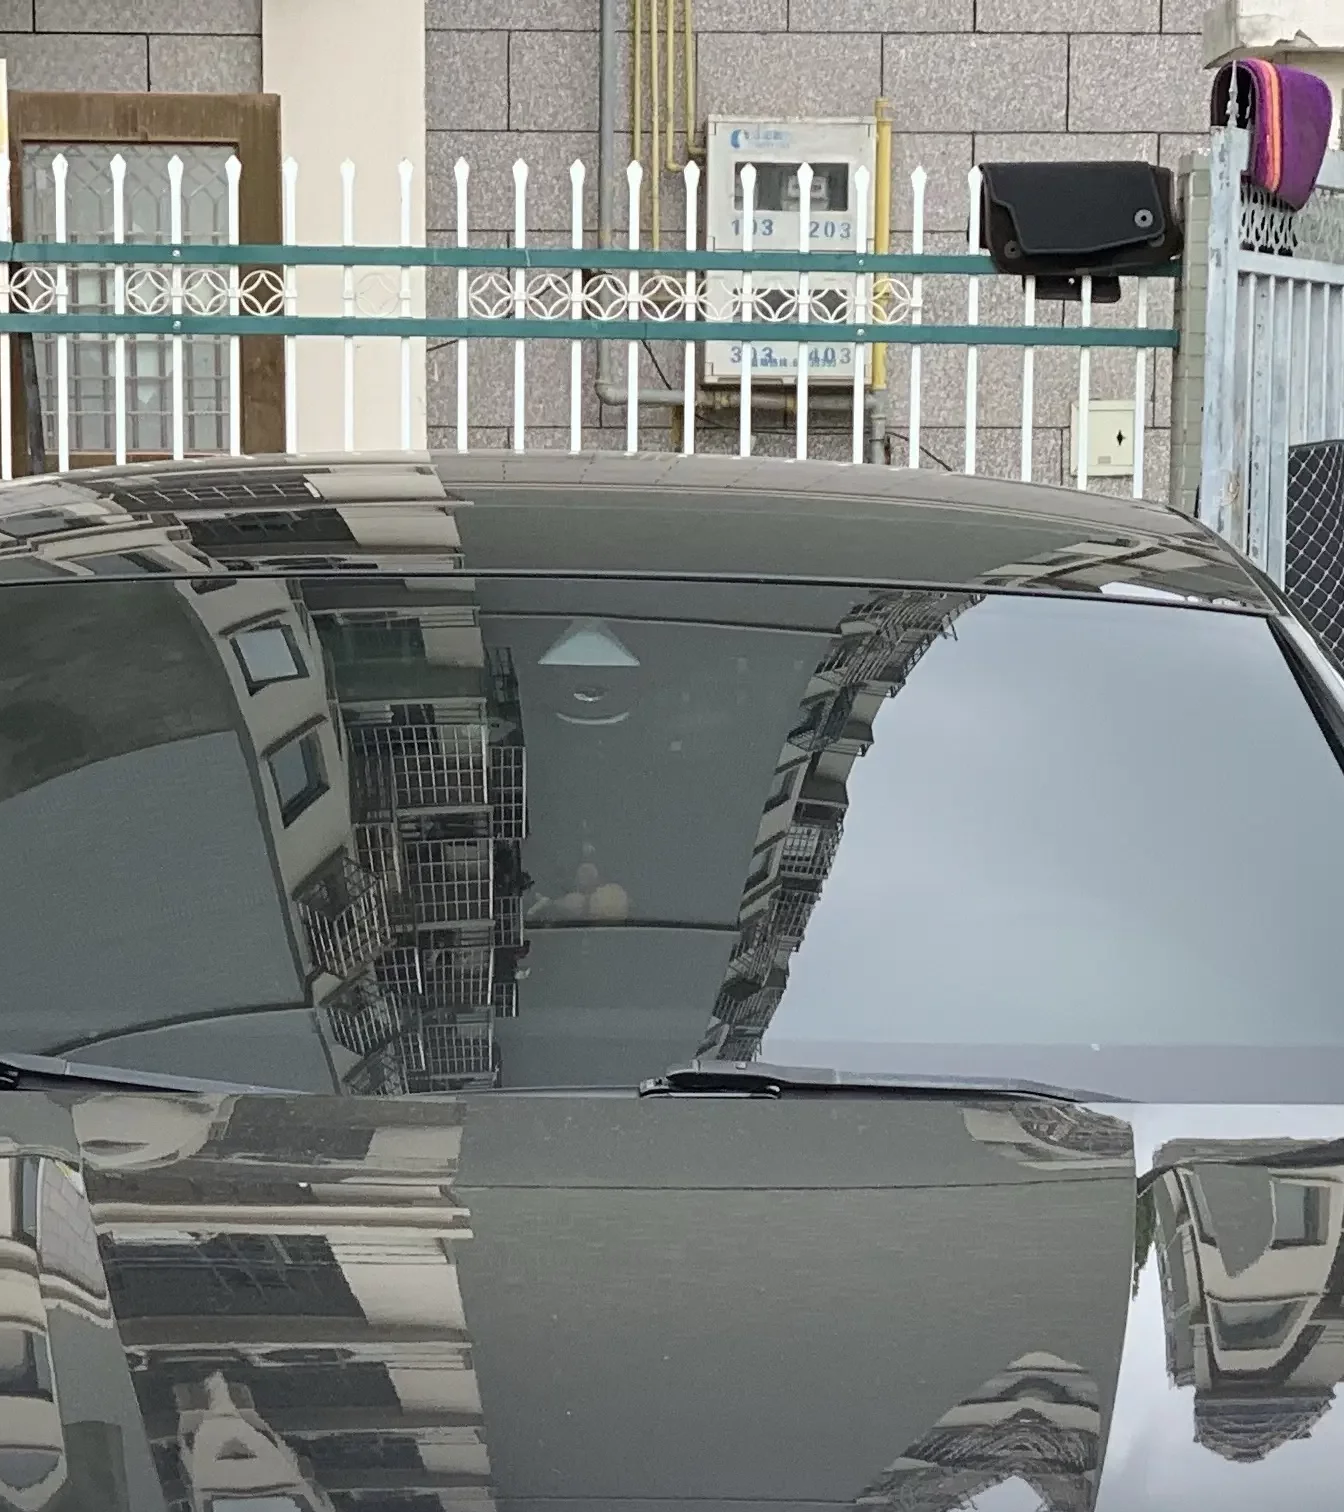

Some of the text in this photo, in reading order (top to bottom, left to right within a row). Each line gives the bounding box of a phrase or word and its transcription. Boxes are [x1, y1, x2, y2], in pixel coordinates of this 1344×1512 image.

[731, 219, 851, 239] 13 203
[730, 346, 774, 365] 33
[808, 347, 851, 365] 403
